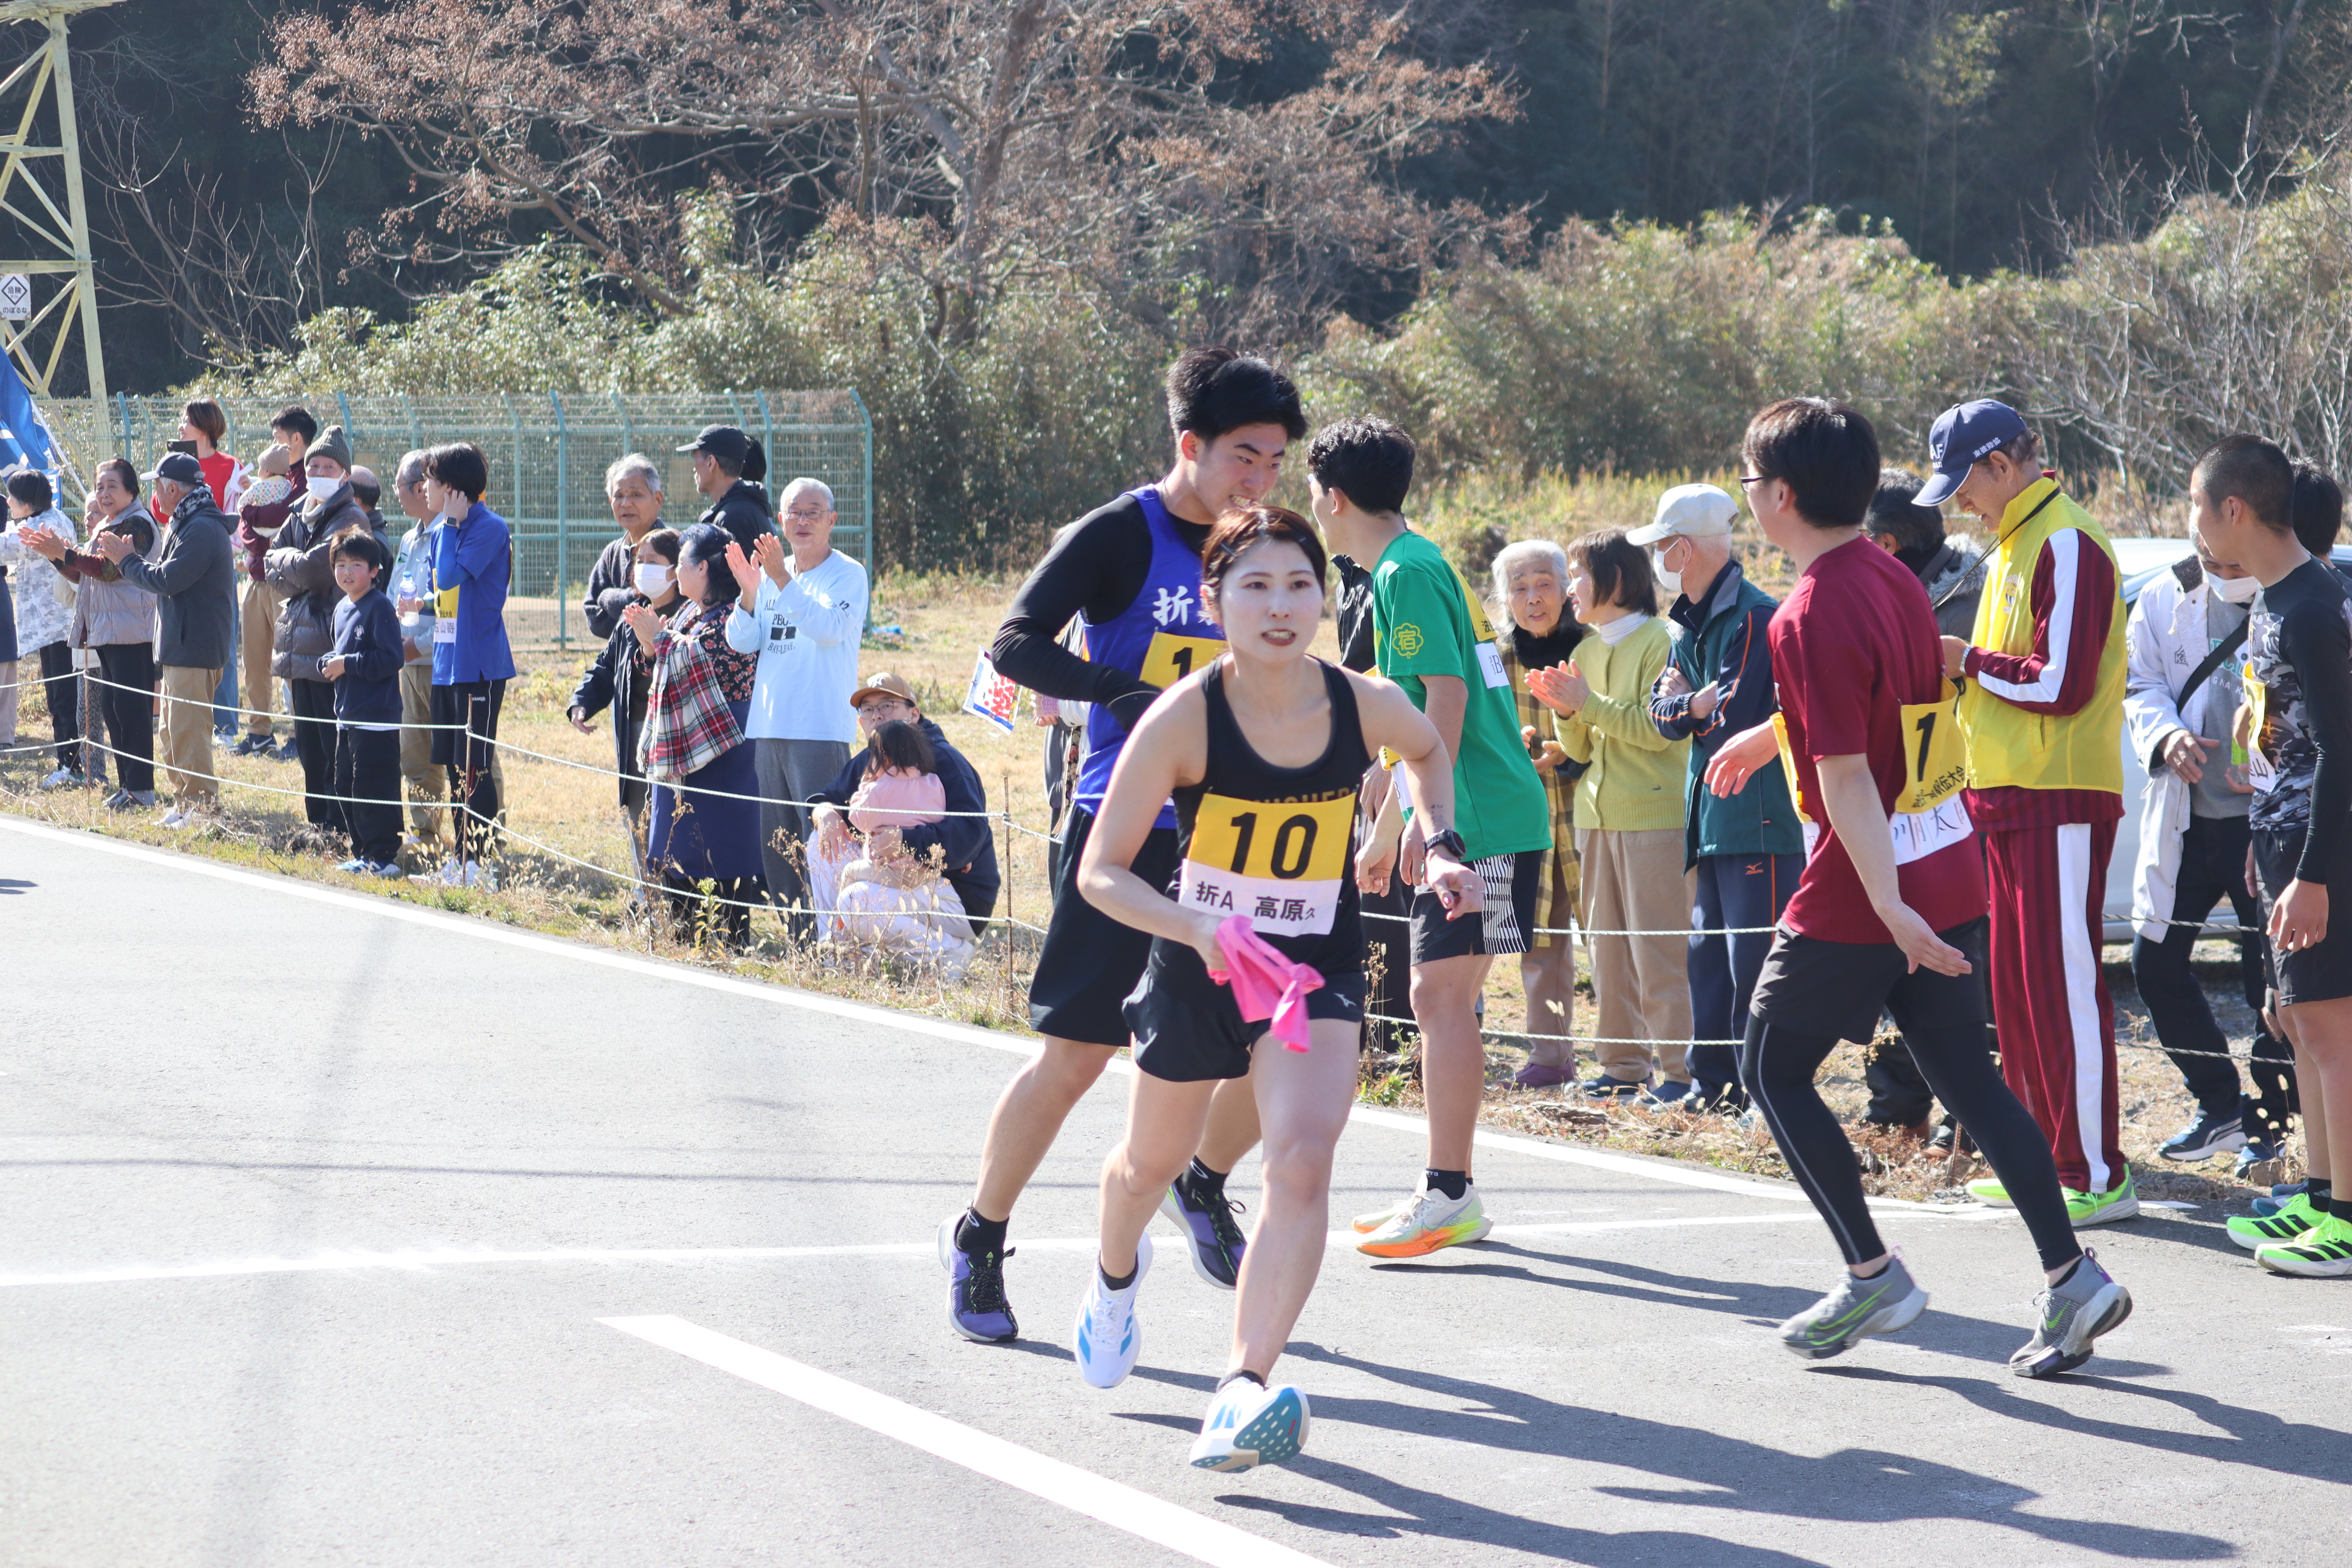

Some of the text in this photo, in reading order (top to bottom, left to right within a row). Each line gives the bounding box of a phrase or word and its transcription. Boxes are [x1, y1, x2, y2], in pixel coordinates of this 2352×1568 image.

[1398, 629, 1416, 651] 宿
[1230, 812, 1318, 879] 10
[1196, 881, 1234, 911] 折A
